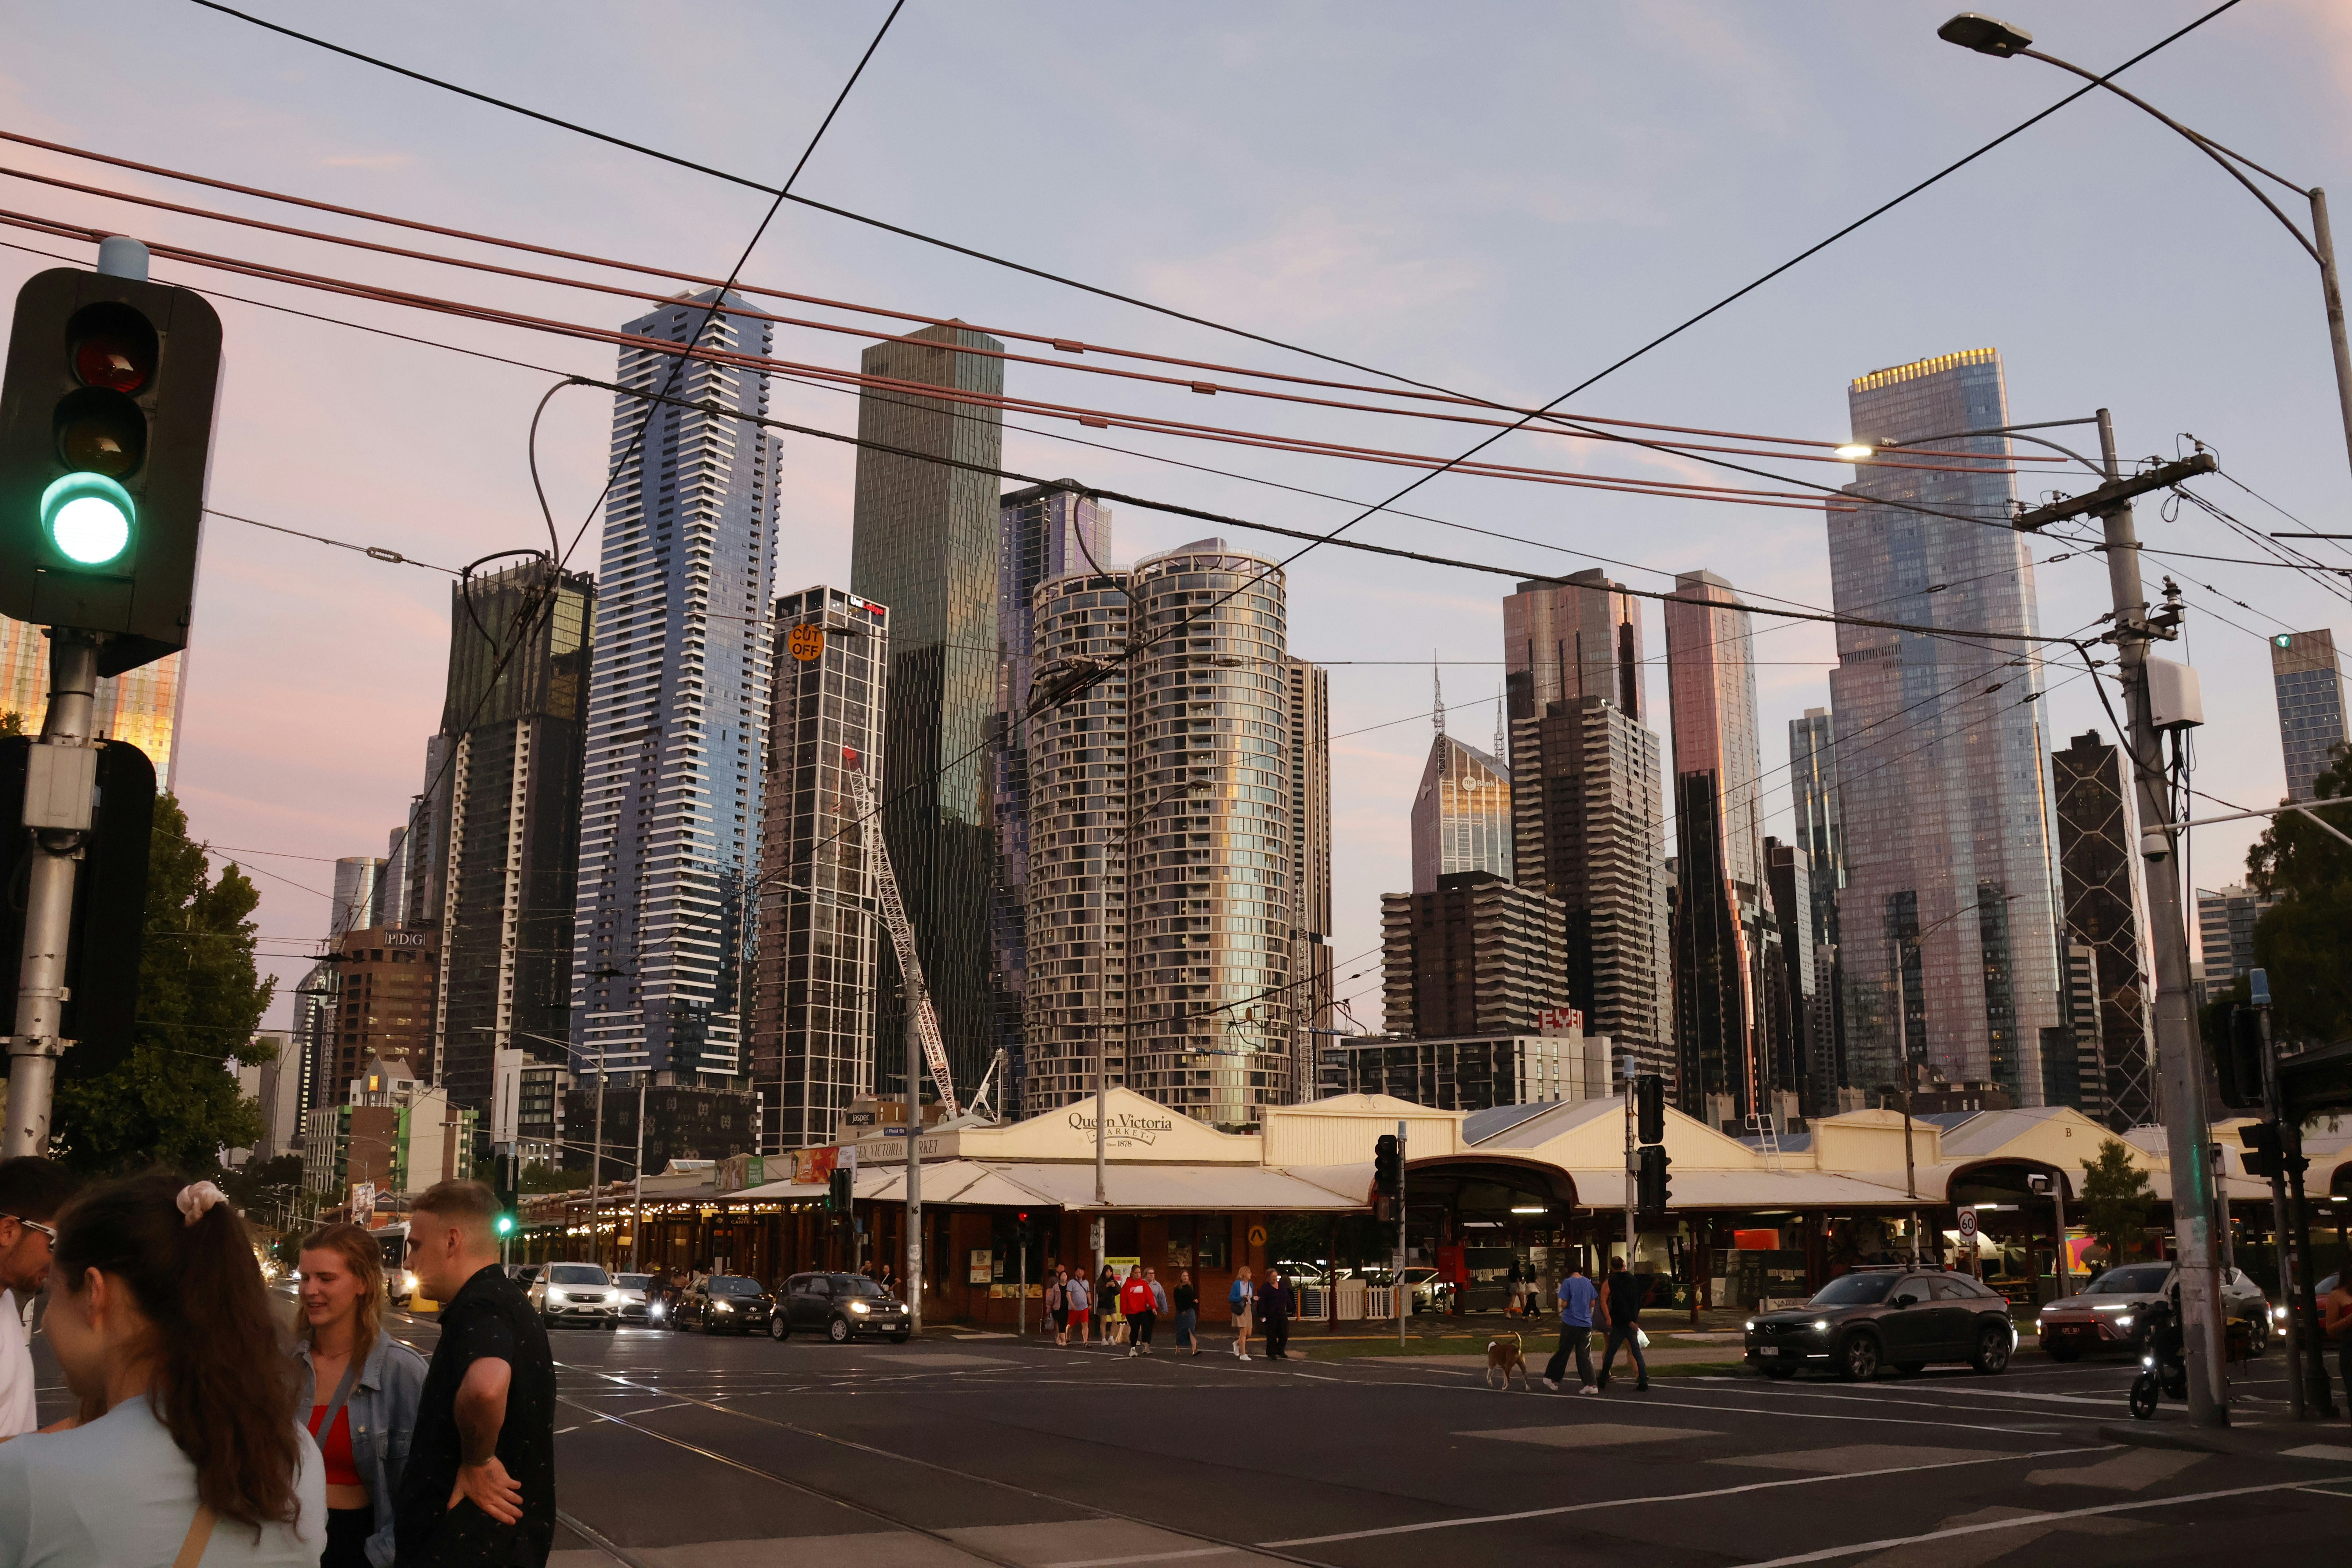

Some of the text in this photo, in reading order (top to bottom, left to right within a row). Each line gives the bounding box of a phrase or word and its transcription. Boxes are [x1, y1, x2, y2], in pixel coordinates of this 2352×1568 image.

[850, 596, 884, 615] UniLodge
[793, 626, 820, 642] CUT
[2278, 636, 2288, 646] Y
[792, 643, 818, 657] OFF
[1069, 1112, 1172, 1130] Quen Victoria
[1107, 1128, 1146, 1138] ARKET
[2065, 1128, 2071, 1137] B
[911, 1206, 918, 1214] 16
[1962, 1218, 1974, 1230] 60
